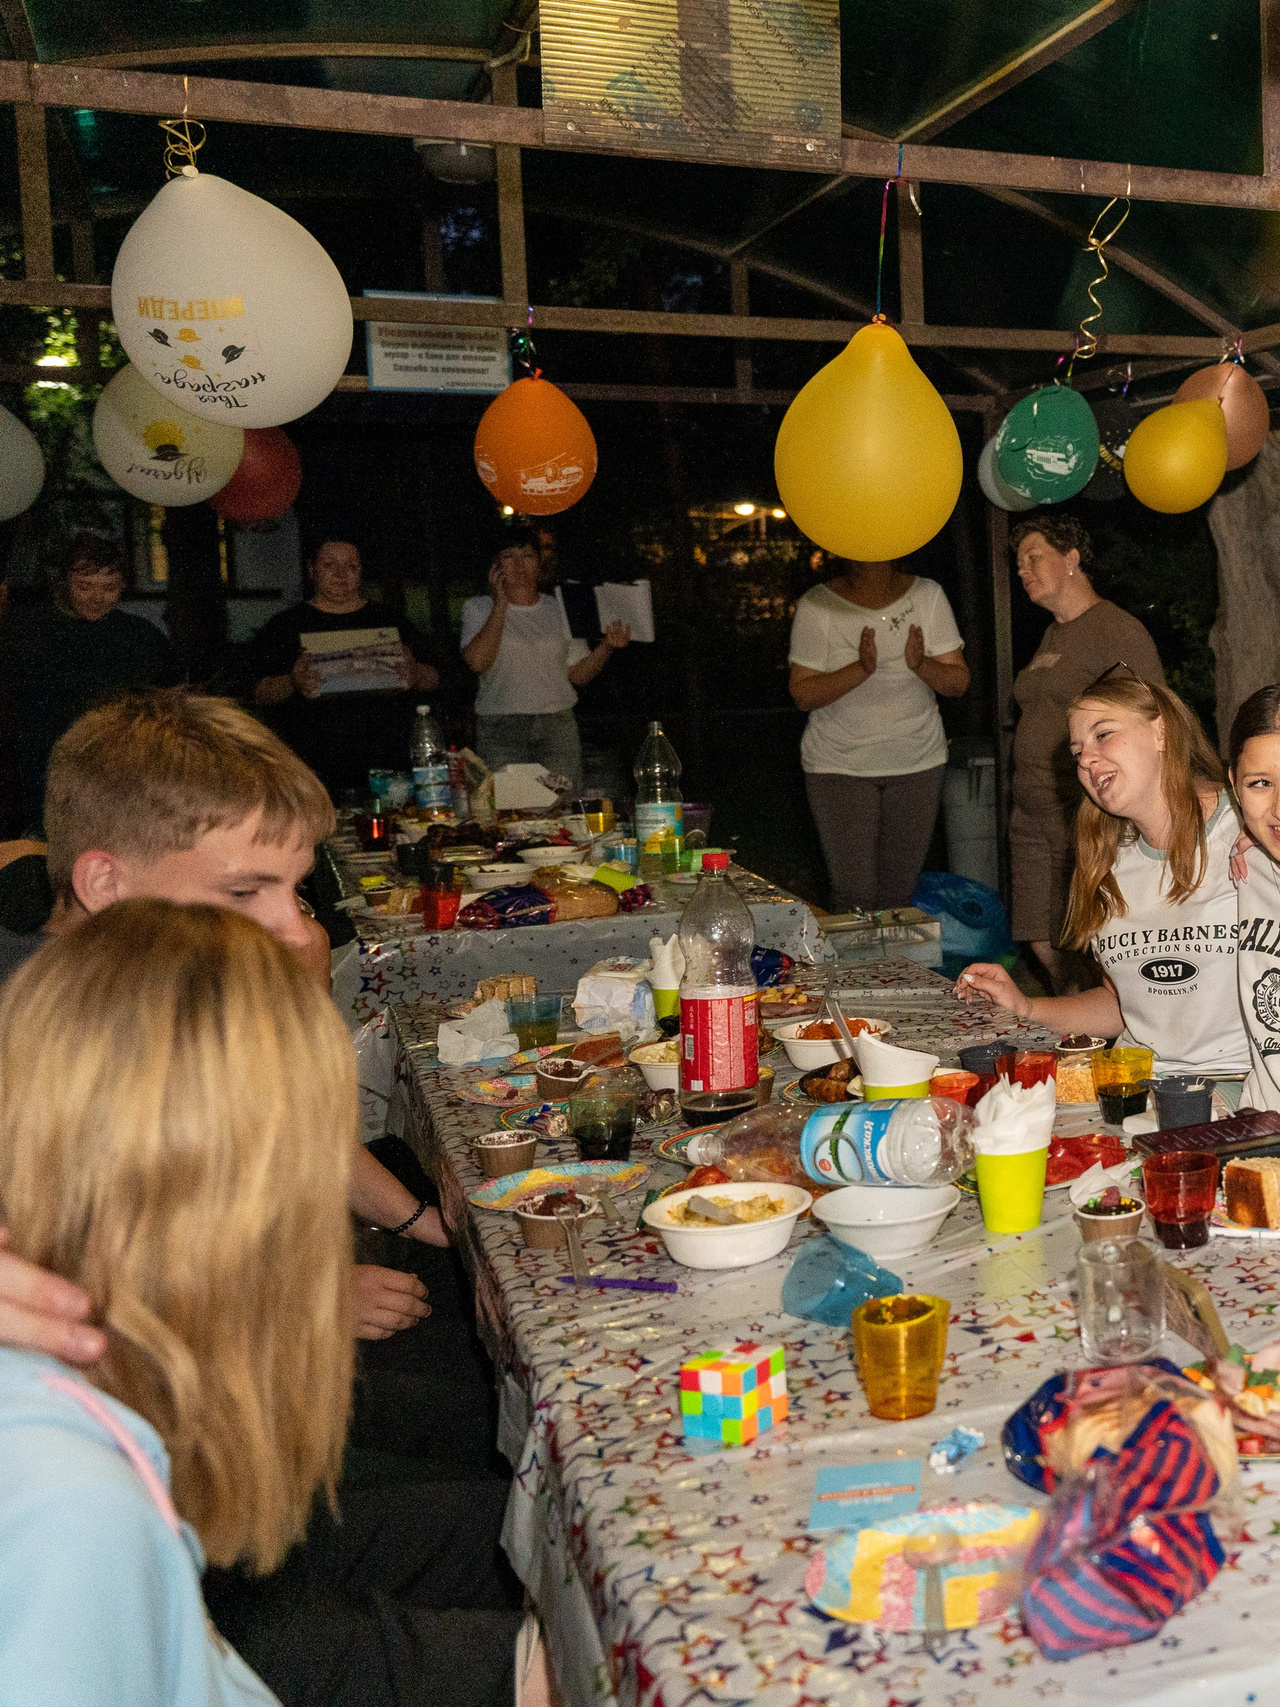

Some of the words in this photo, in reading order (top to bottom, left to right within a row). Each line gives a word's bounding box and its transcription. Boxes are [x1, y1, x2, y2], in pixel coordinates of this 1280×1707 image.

[137, 296, 245, 321] ВПЕРЕДИ
[154, 369, 267, 394] награда
[195, 394, 248, 409] Твоя
[126, 457, 208, 485] Удачи!
[1157, 924, 1239, 943] BARNES
[1104, 943, 1180, 969] PROTECTION
[1185, 943, 1235, 955] SQUAD
[1151, 964, 1183, 978] 1917
